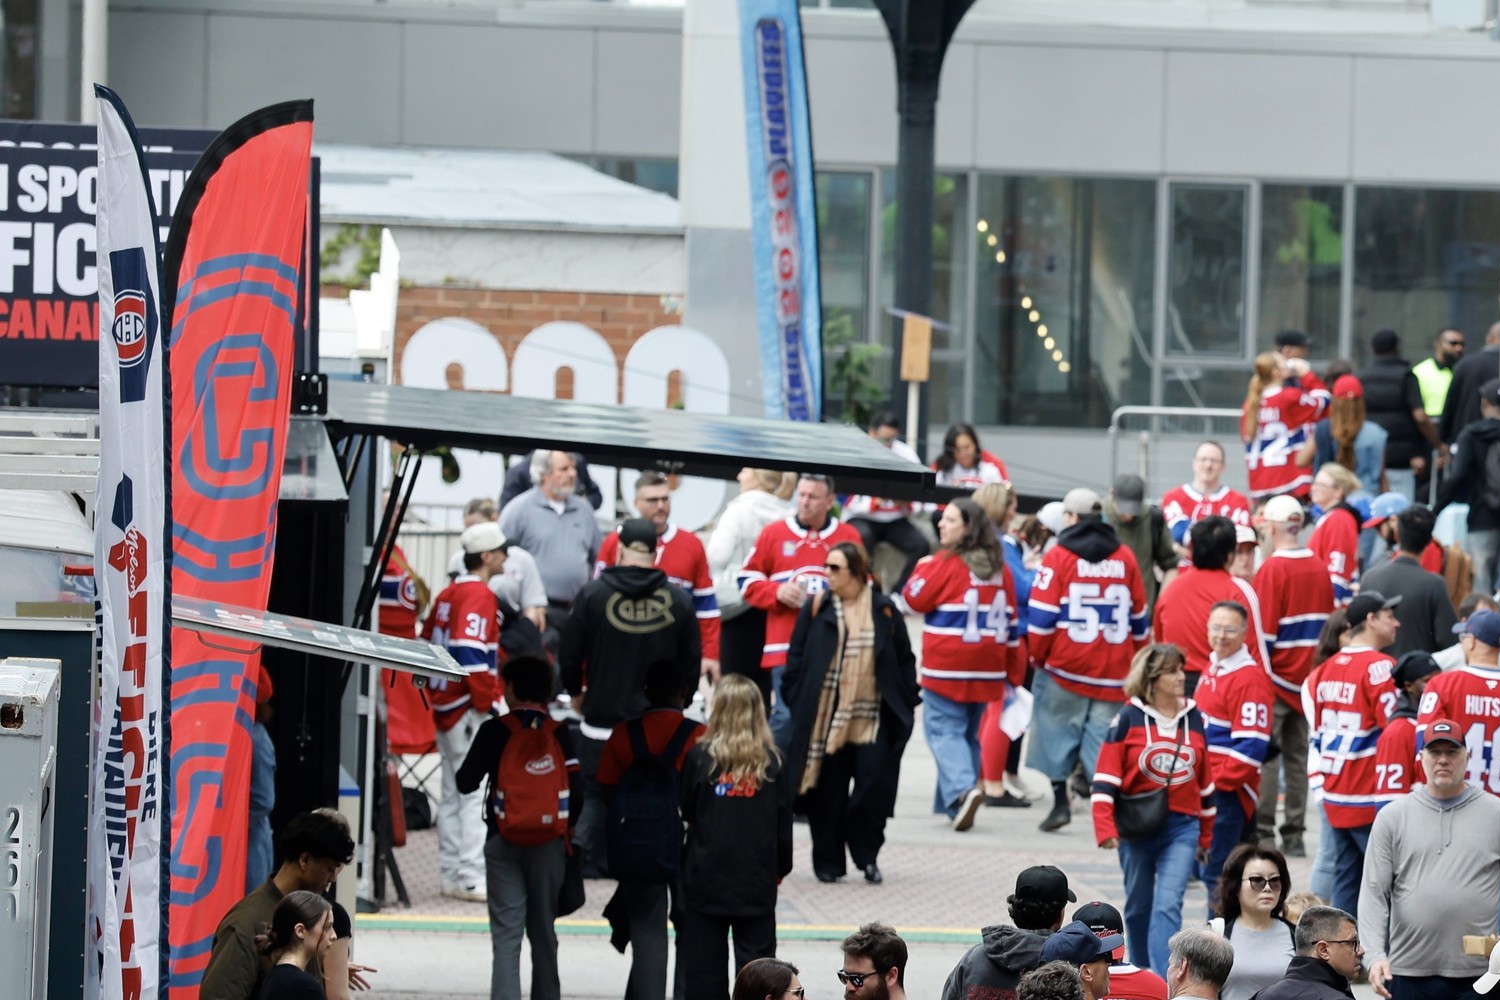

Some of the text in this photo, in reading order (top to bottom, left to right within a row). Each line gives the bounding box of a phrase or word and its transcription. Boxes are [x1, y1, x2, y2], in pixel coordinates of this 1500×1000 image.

[465, 612, 488, 640] 31
[962, 587, 1008, 644] 14
[1068, 582, 1131, 645] 53
[1241, 701, 1269, 729] 93
